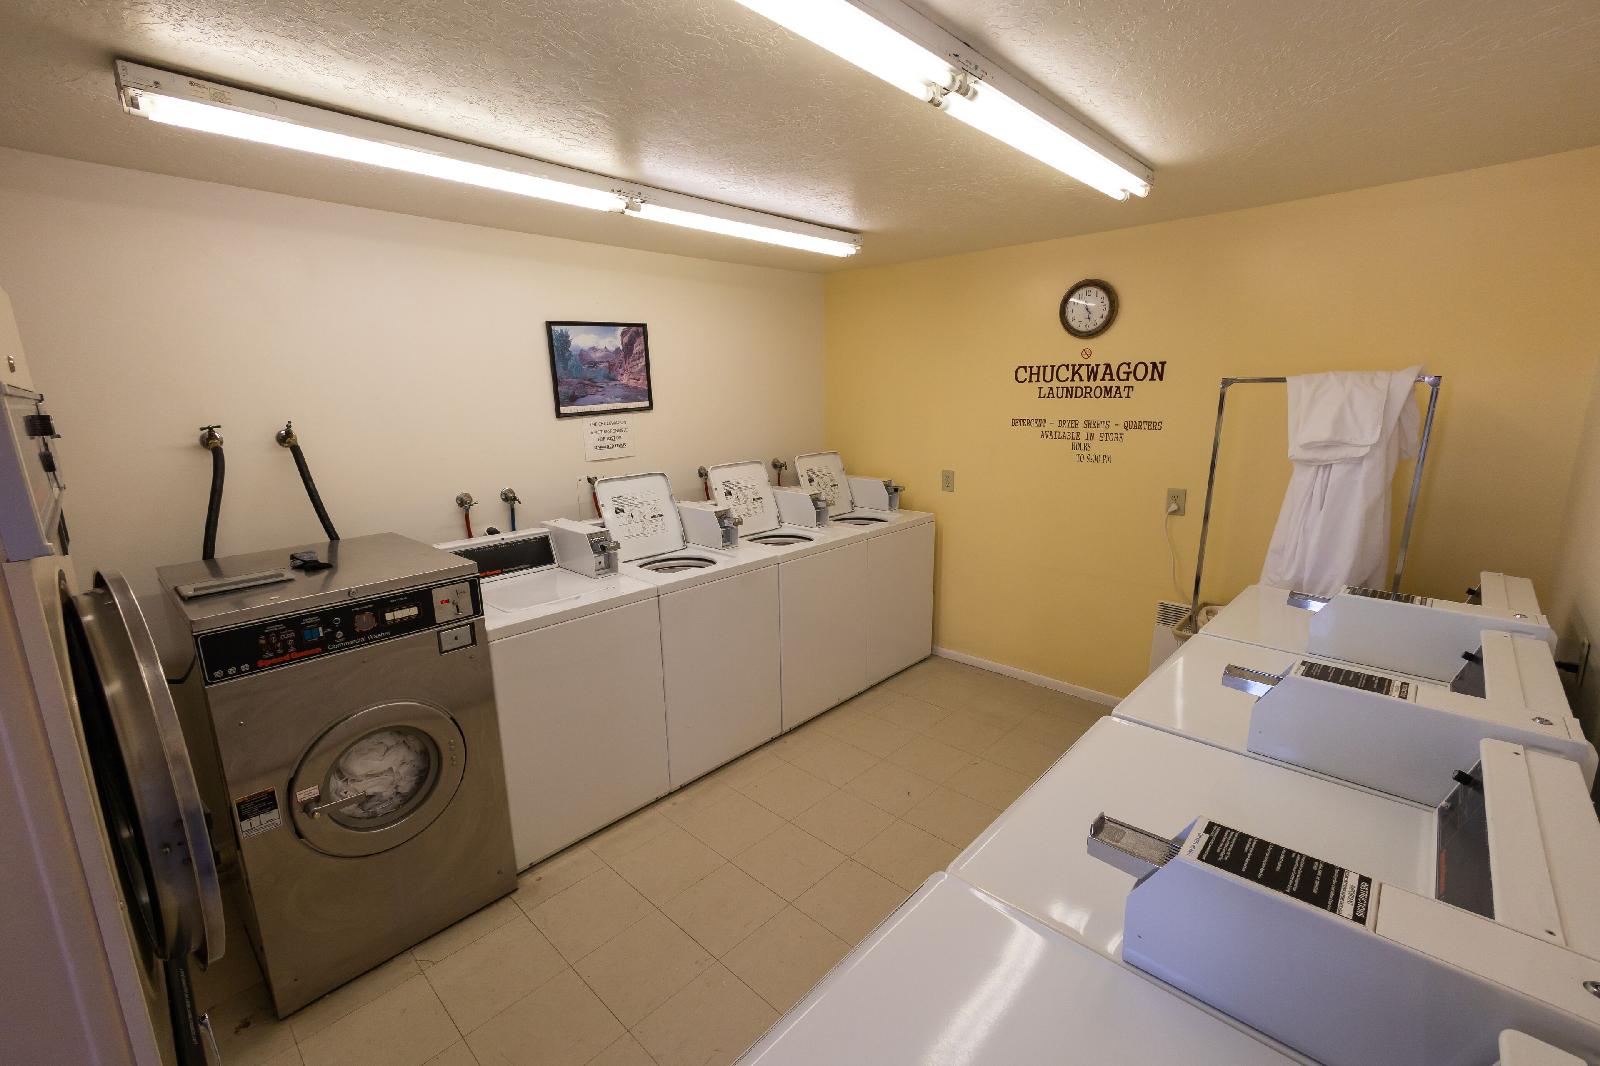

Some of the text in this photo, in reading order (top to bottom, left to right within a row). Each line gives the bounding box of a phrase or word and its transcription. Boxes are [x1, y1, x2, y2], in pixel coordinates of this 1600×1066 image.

[1014, 361, 1167, 383] CHUCKWAGON
[1037, 386, 1134, 399] LAUNDROMAT
[1058, 419, 1079, 429] DRYER
[1123, 420, 1163, 431] QUARTERS
[1040, 430, 1081, 441] AVAILABLE
[1084, 431, 1095, 441] IN
